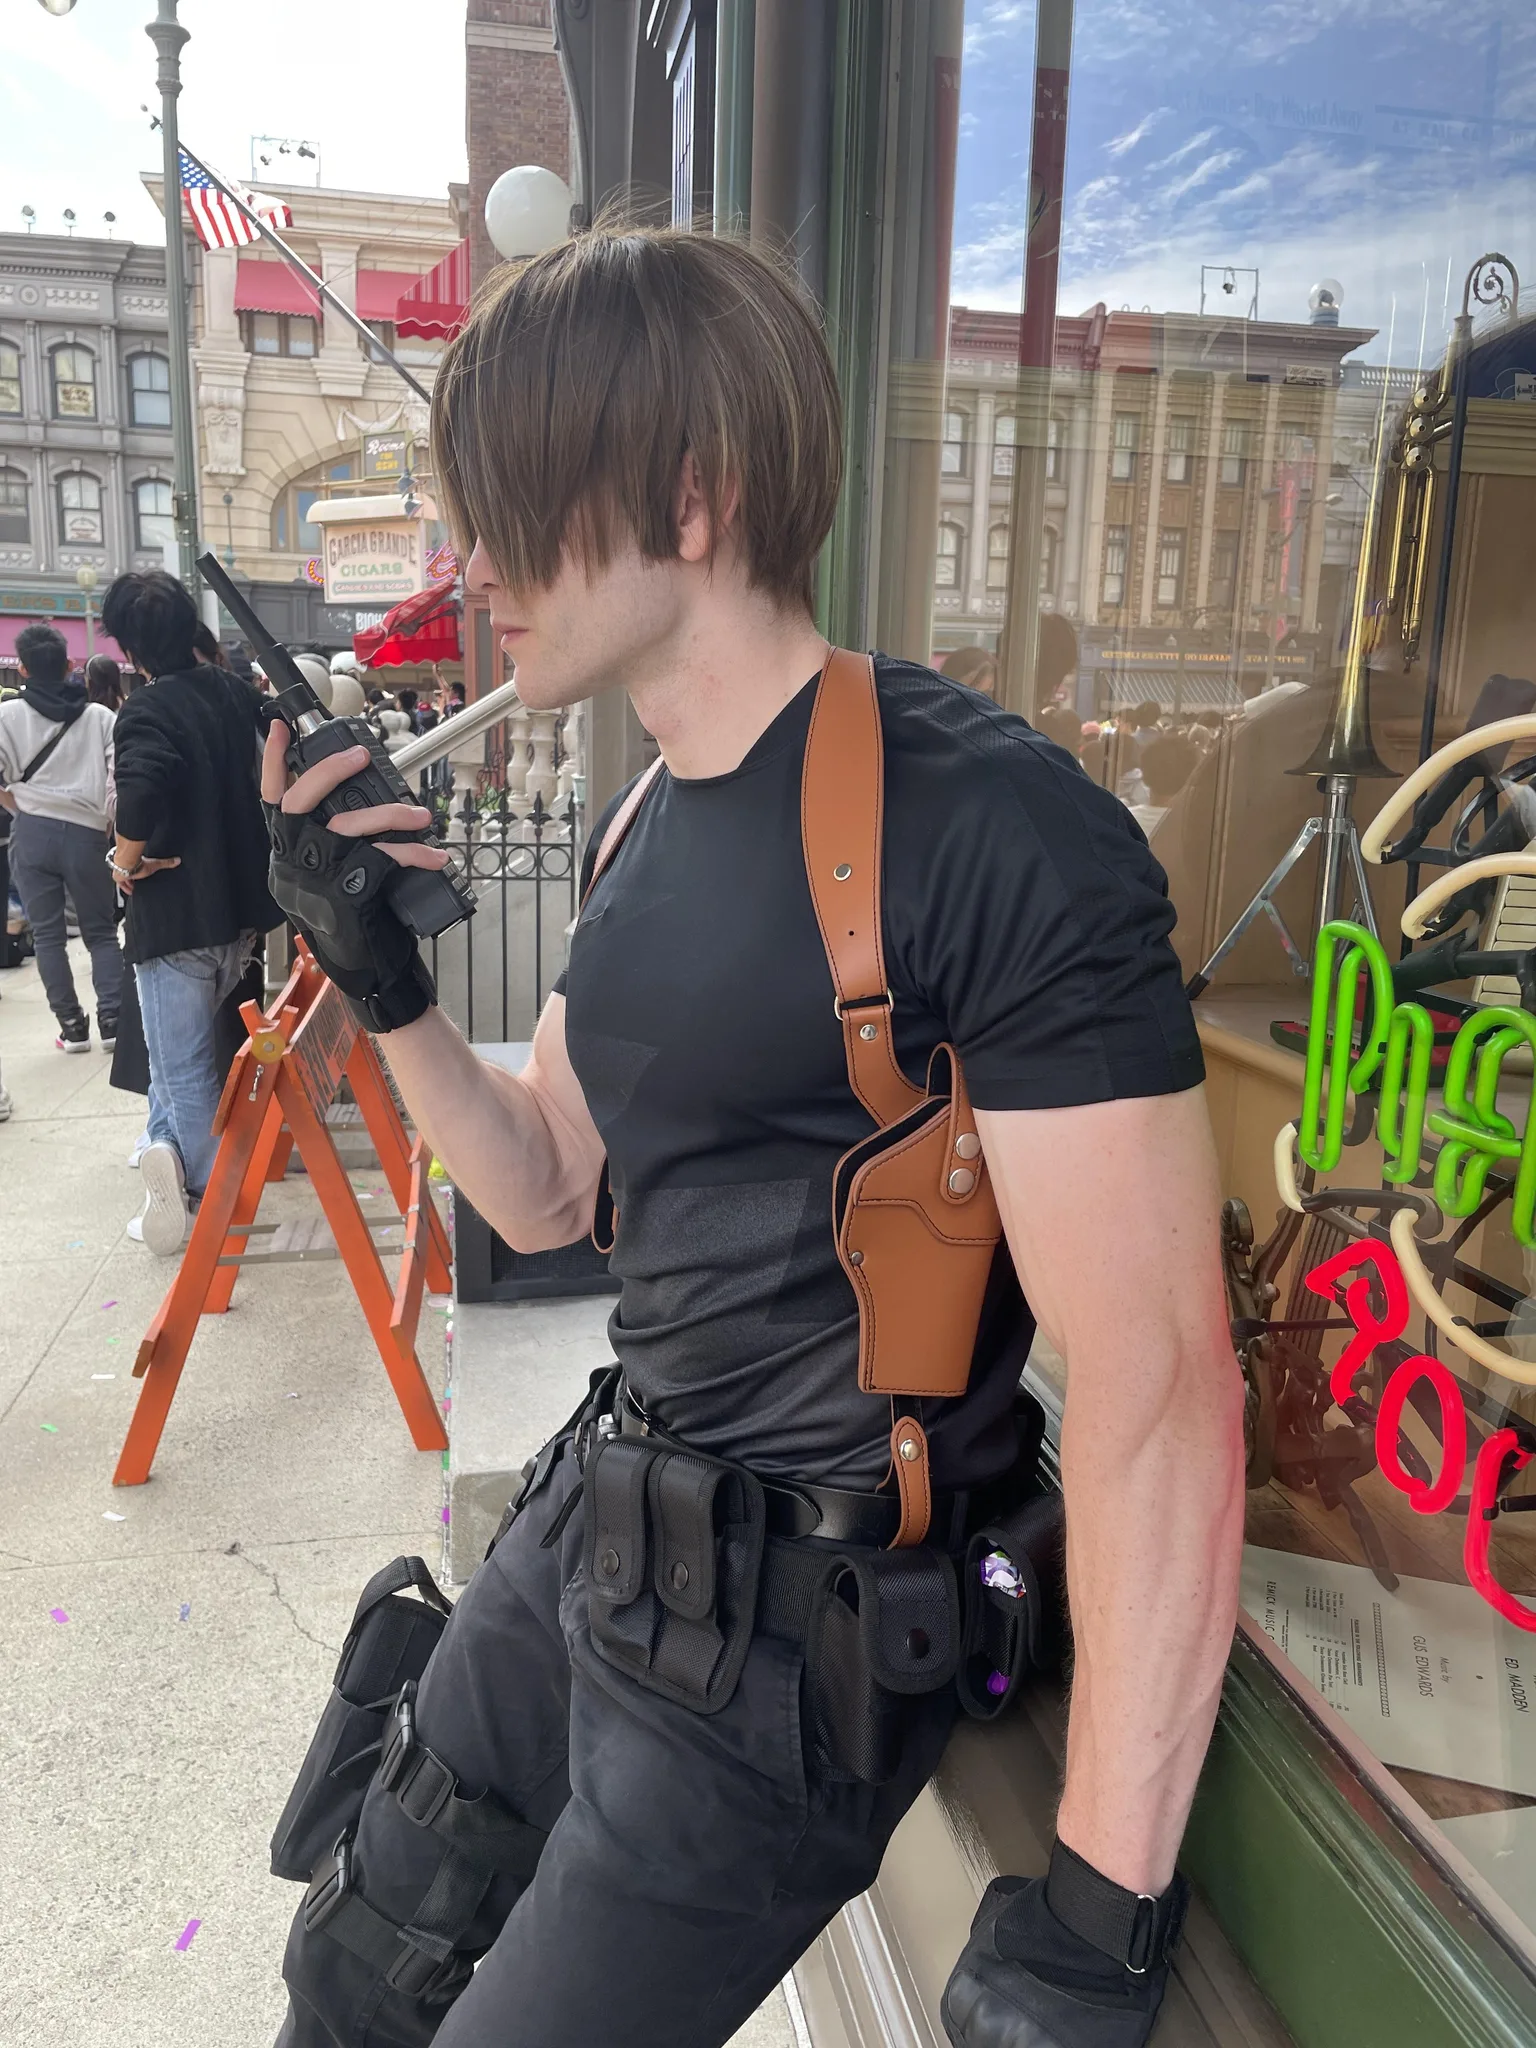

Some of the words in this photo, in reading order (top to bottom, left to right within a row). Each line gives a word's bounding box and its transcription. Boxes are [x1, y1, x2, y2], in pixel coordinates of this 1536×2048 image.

[329, 531, 369, 567] GARCIA
[369, 530, 418, 566] GRANDE
[340, 562, 404, 577] CIGARS
[1266, 1580, 1277, 1605] REMICK
[1265, 1608, 1275, 1631] MUSIC
[1413, 1635, 1428, 1653] GUS
[1415, 1655, 1434, 1698] EDWARDS
[1439, 1656, 1450, 1674] Music
[1440, 1673, 1452, 1683] by
[1508, 1673, 1530, 1713] MADDEN
